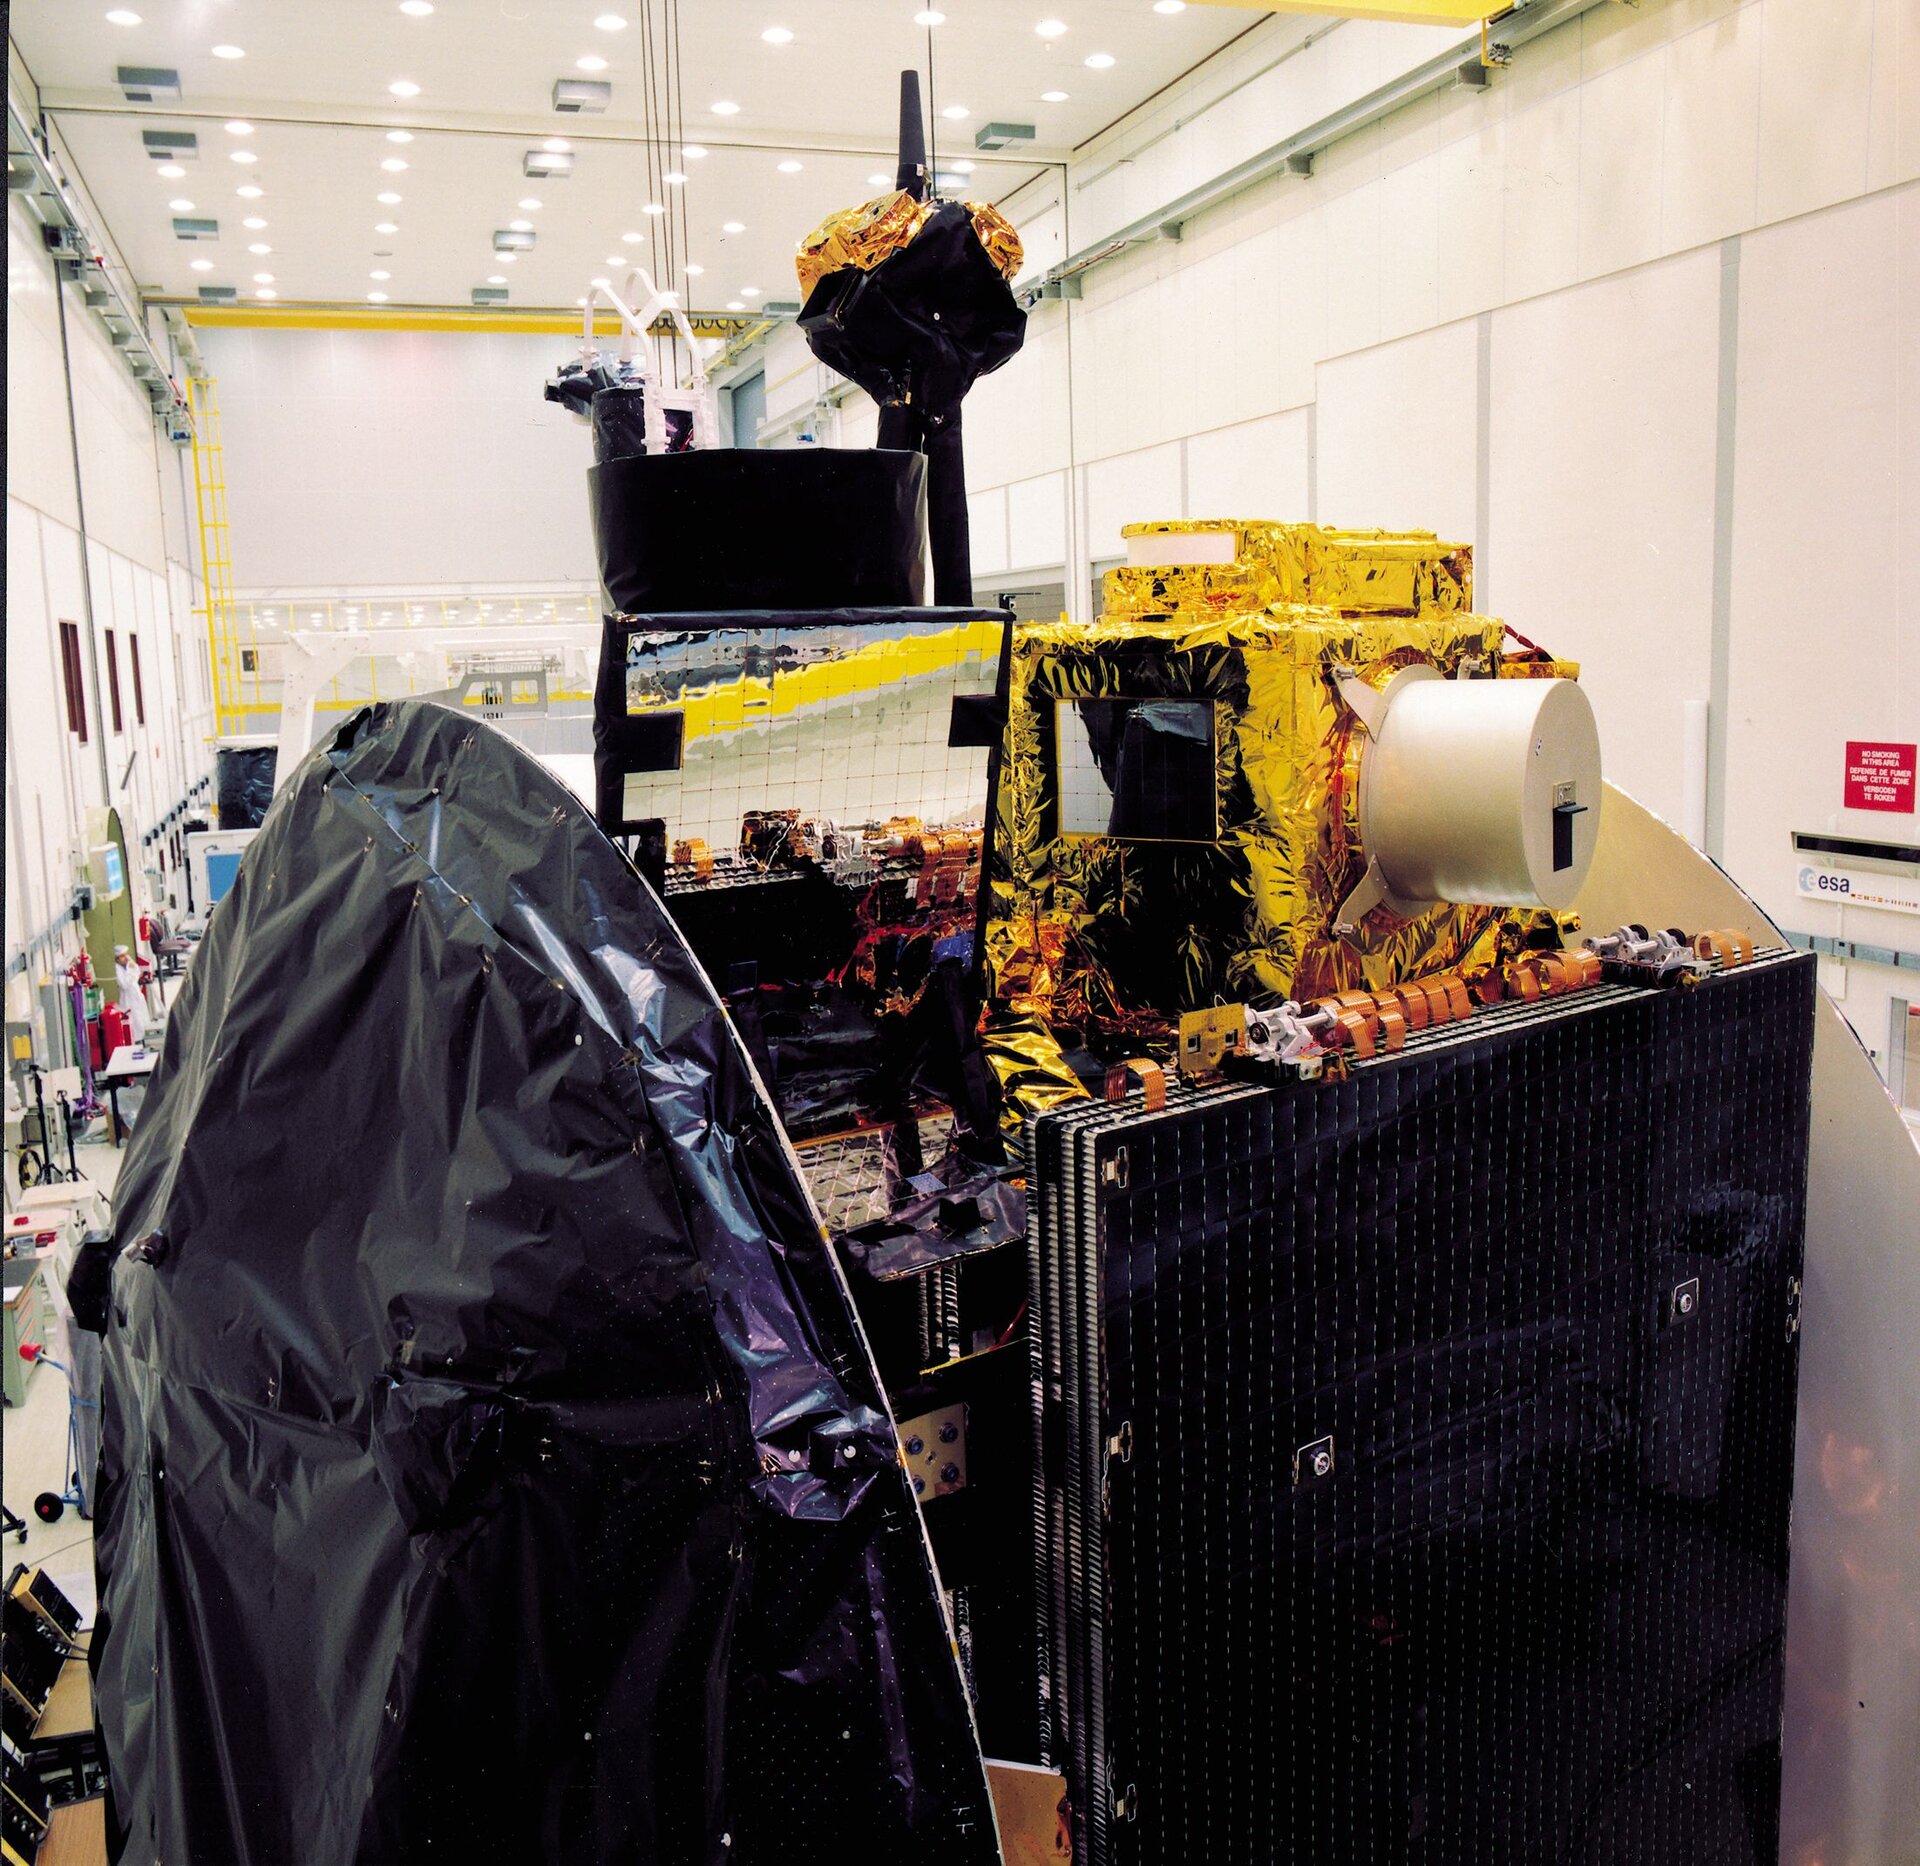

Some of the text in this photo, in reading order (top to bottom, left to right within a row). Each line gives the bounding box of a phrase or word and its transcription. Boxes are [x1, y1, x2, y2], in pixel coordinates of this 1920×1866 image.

[1871, 751, 1899, 759] SMOKING
[1869, 758, 1882, 766] THIS
[1883, 759, 1899, 767] AREA
[1890, 769, 1911, 777] FUMER
[1870, 776, 1890, 784] CETTE
[1892, 777, 1909, 785] ZONE
[1864, 785, 1896, 794] VERBODEN
[1874, 794, 1895, 802] ROKEN
[1818, 875, 1849, 893] esa
